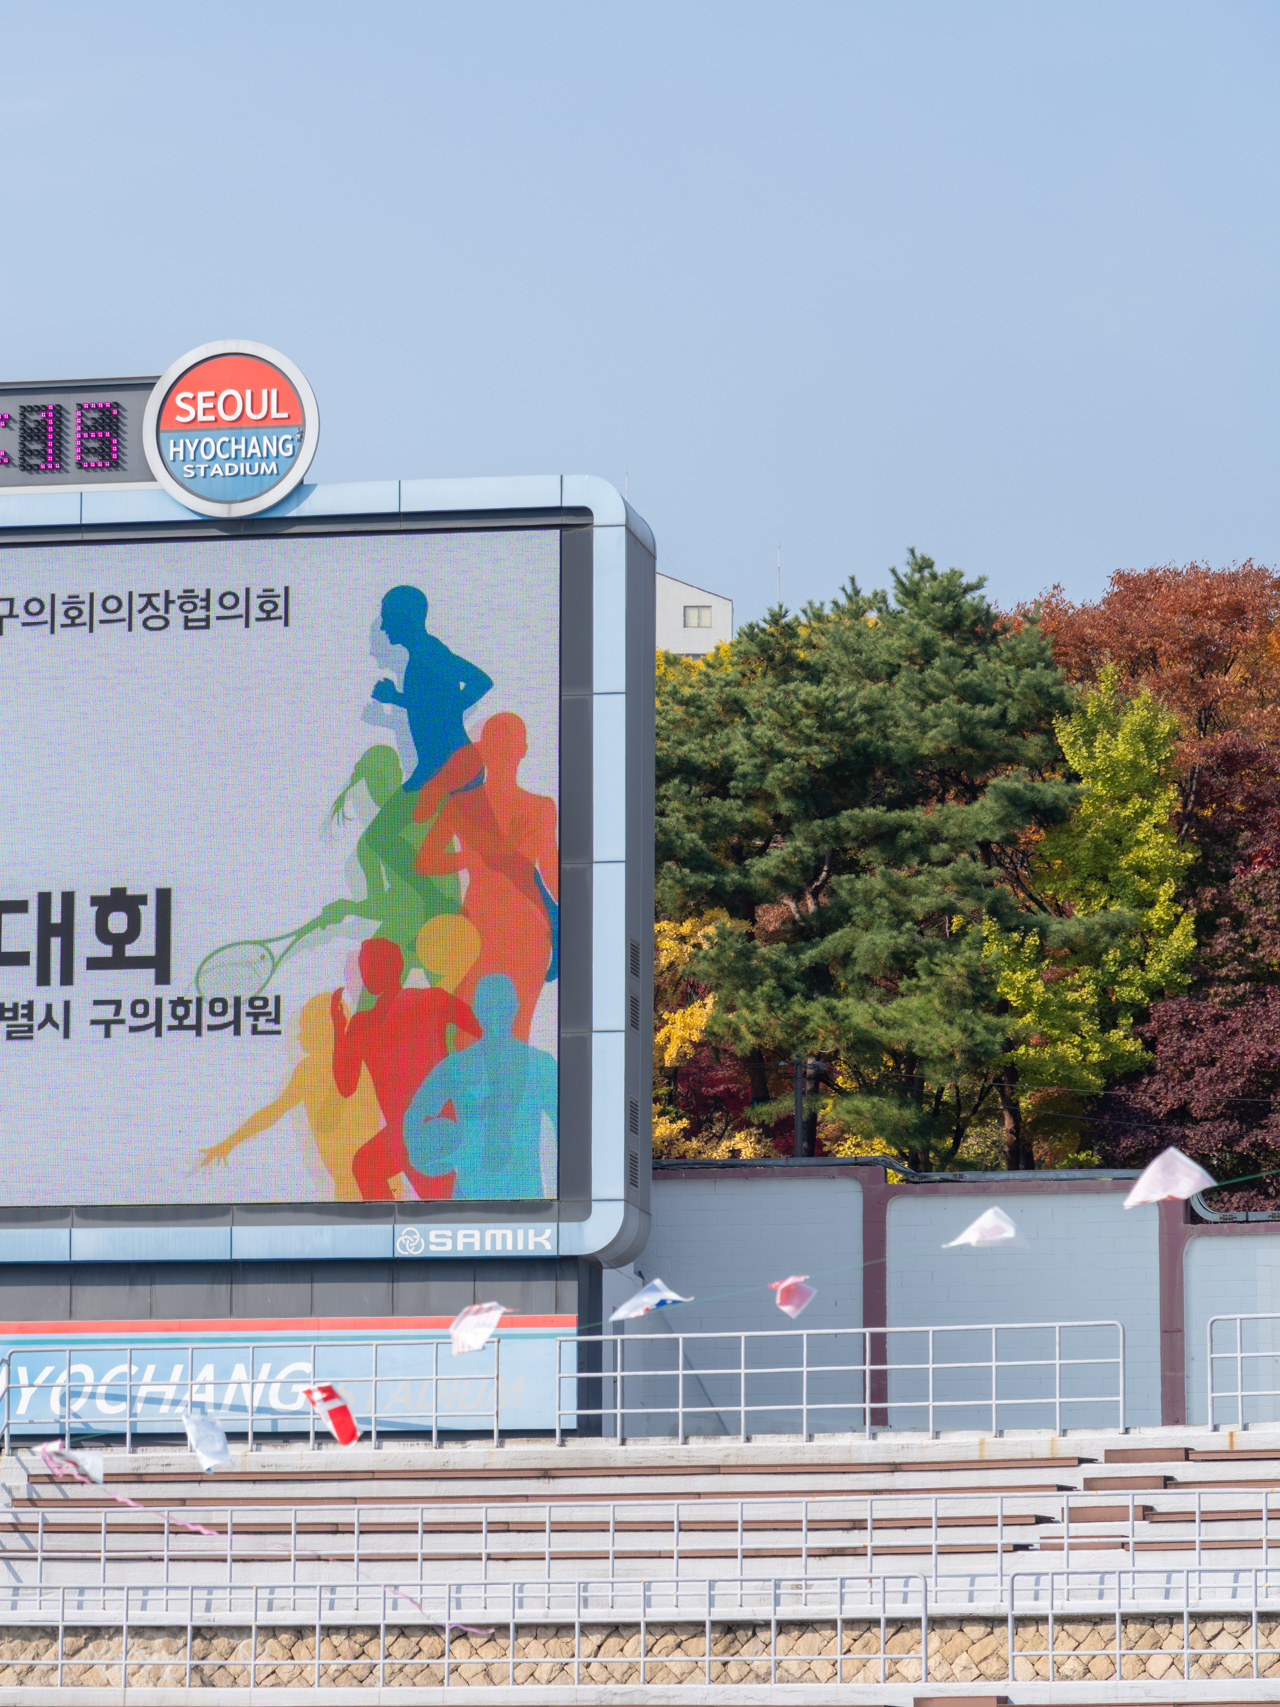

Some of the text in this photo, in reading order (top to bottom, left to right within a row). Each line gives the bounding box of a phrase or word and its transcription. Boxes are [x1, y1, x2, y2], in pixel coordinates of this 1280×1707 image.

[175, 388, 288, 422] SEOUL
[169, 434, 294, 461] HYOCHANG
[182, 461, 278, 478] STADIUM
[89, 994, 283, 1038] 구의회의원
[429, 1228, 552, 1251] SAMIK
